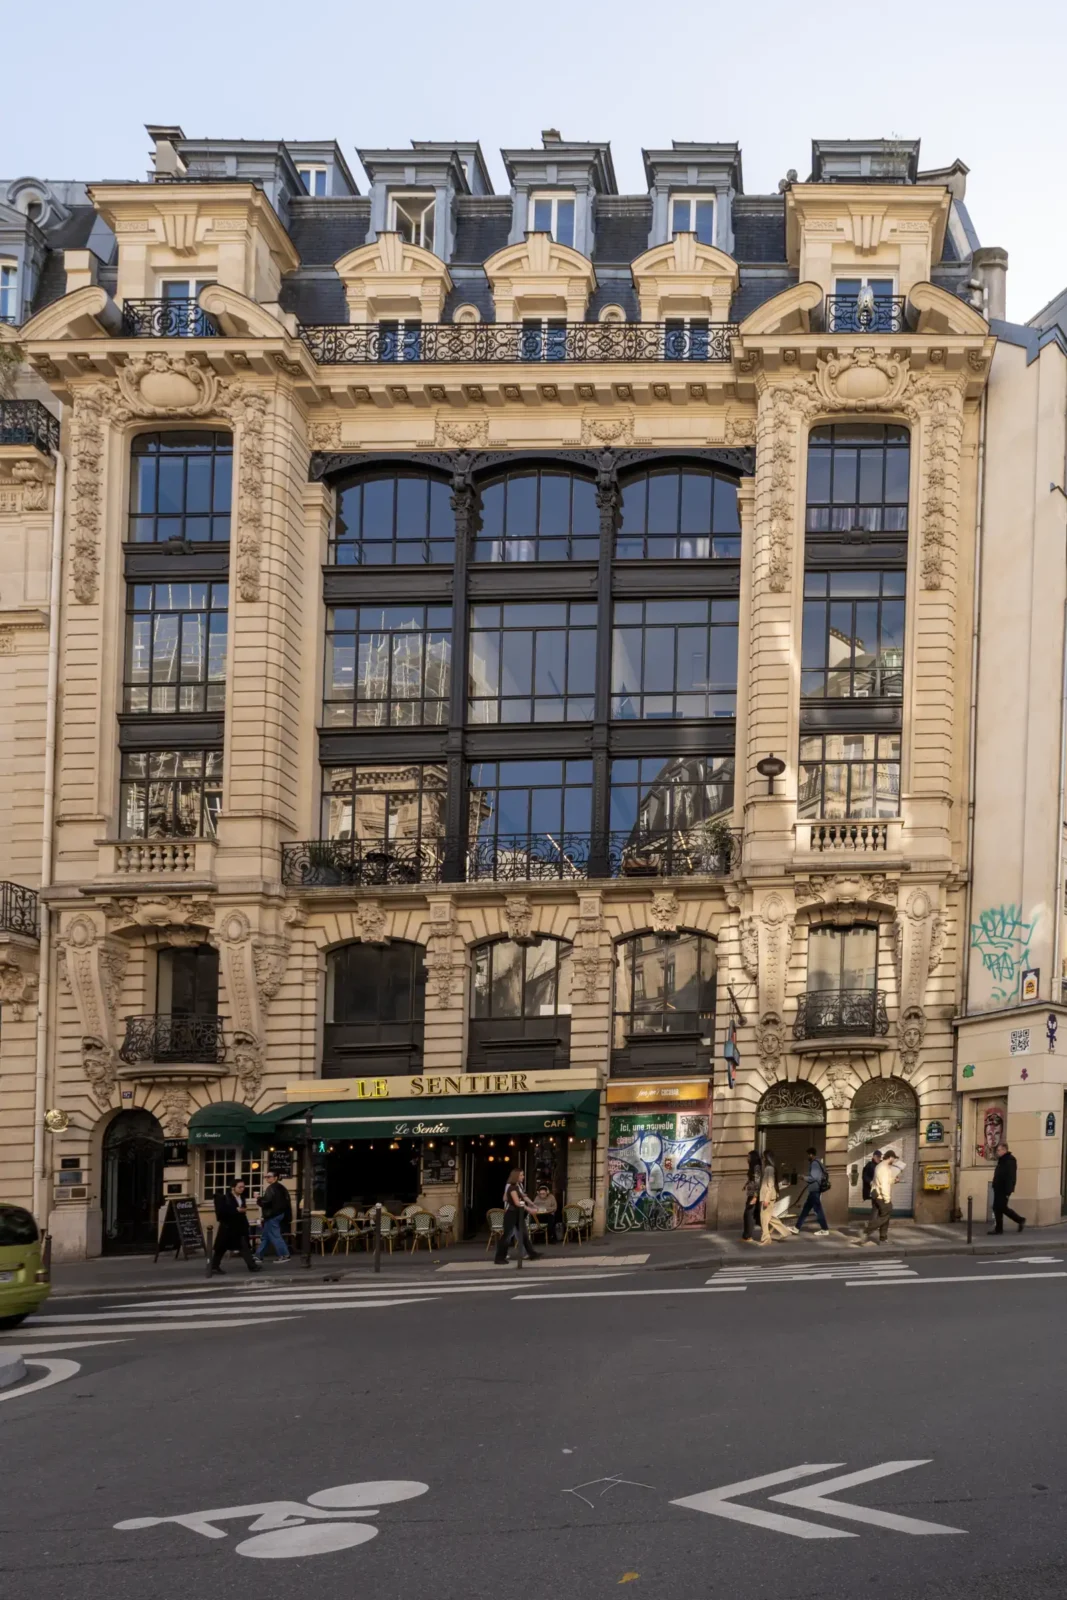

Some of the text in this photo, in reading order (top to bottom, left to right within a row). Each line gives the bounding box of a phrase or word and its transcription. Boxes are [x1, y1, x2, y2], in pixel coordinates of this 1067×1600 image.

[356, 1073, 529, 1099] LE SENTIER
[393, 1122, 450, 1135] Le Sentier
[544, 1118, 566, 1128] CAFÉ
[632, 1122, 645, 1131] une
[646, 1121, 674, 1131] nouvelle
